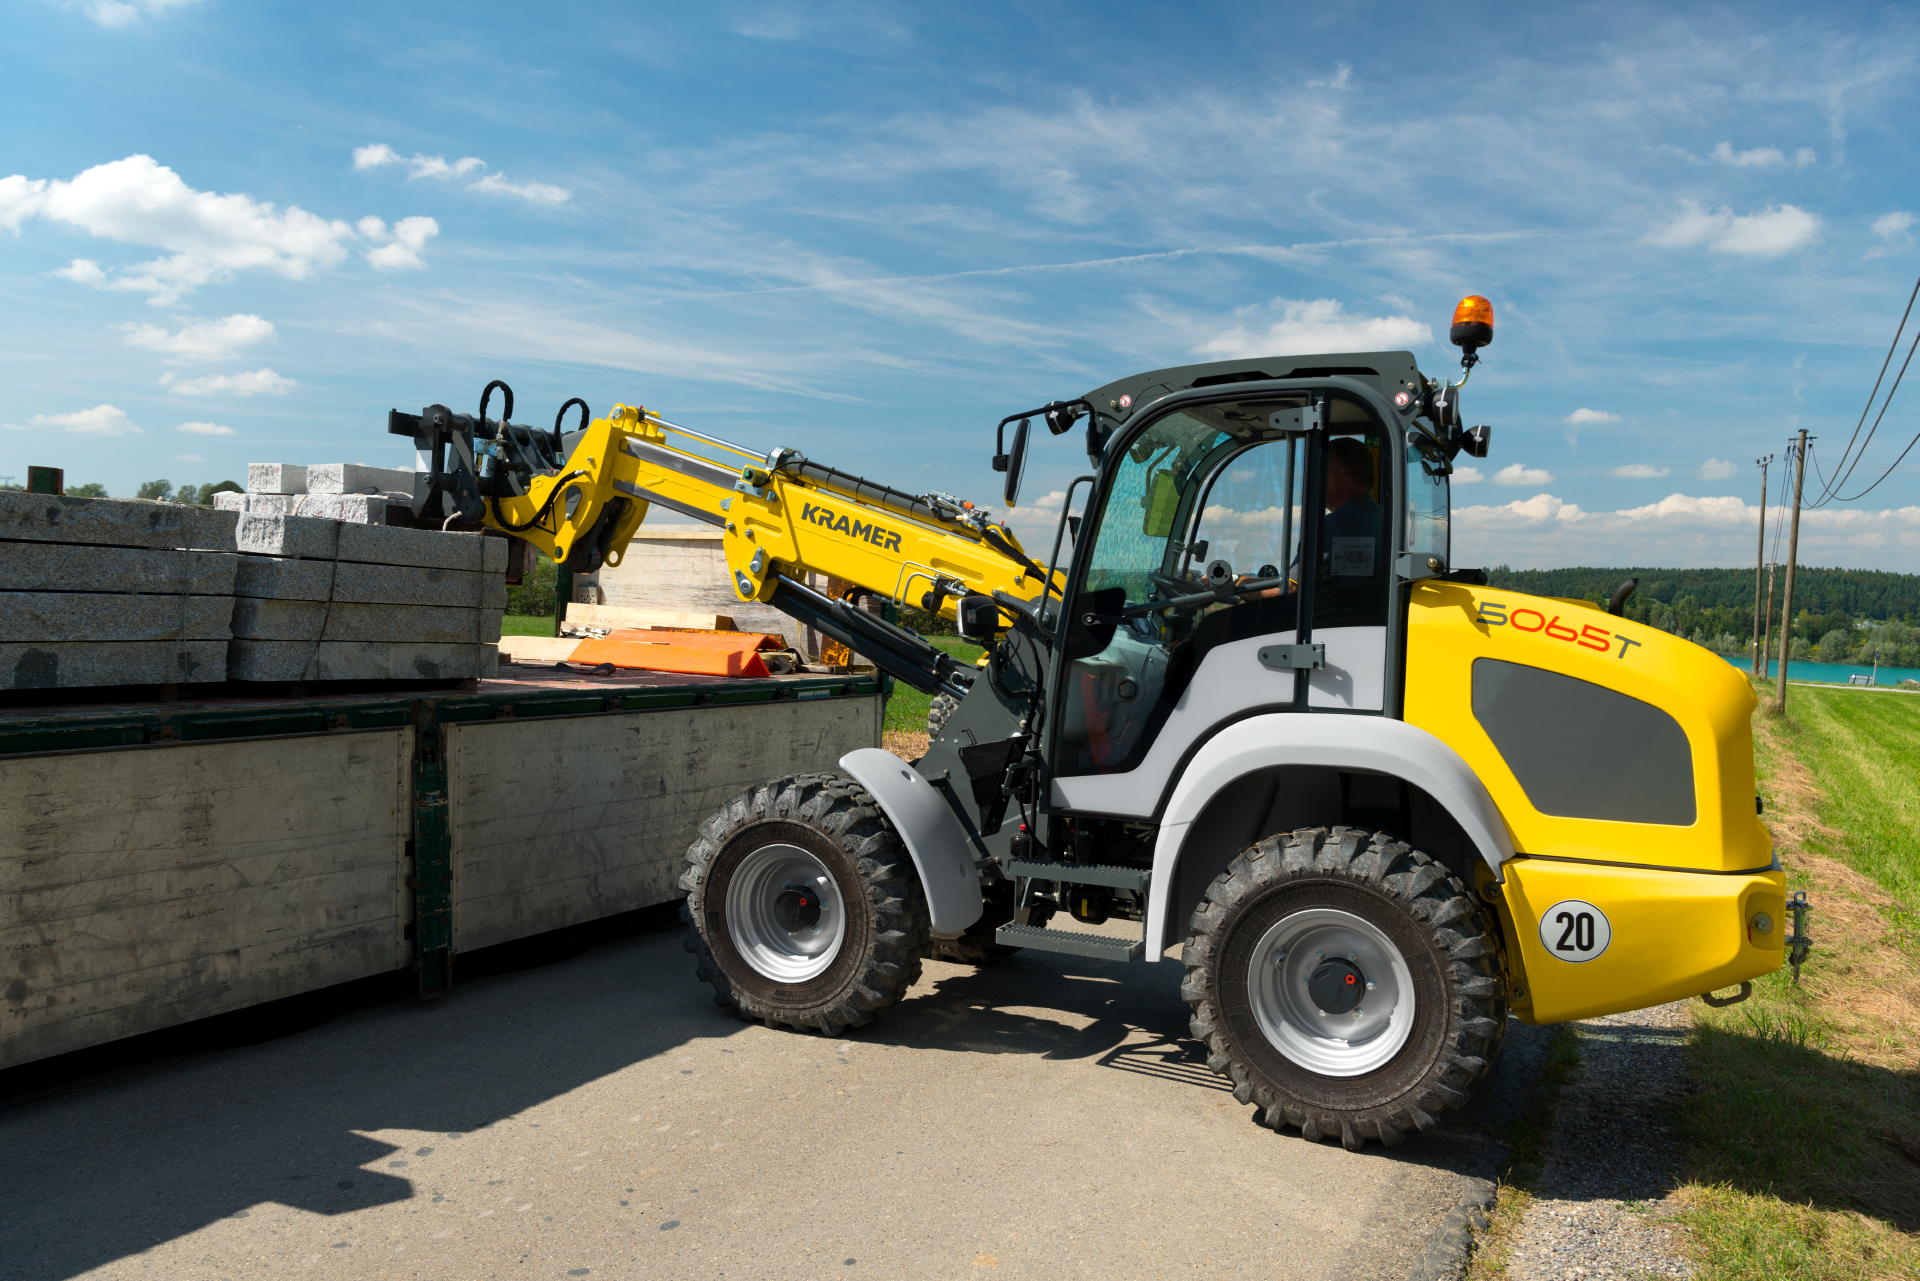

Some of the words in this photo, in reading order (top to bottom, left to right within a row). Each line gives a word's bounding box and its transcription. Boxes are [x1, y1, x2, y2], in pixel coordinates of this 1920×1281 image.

[801, 502, 902, 553] KRAMER
[1476, 601, 1642, 659] 5065T
[1556, 911, 1594, 951] 20
